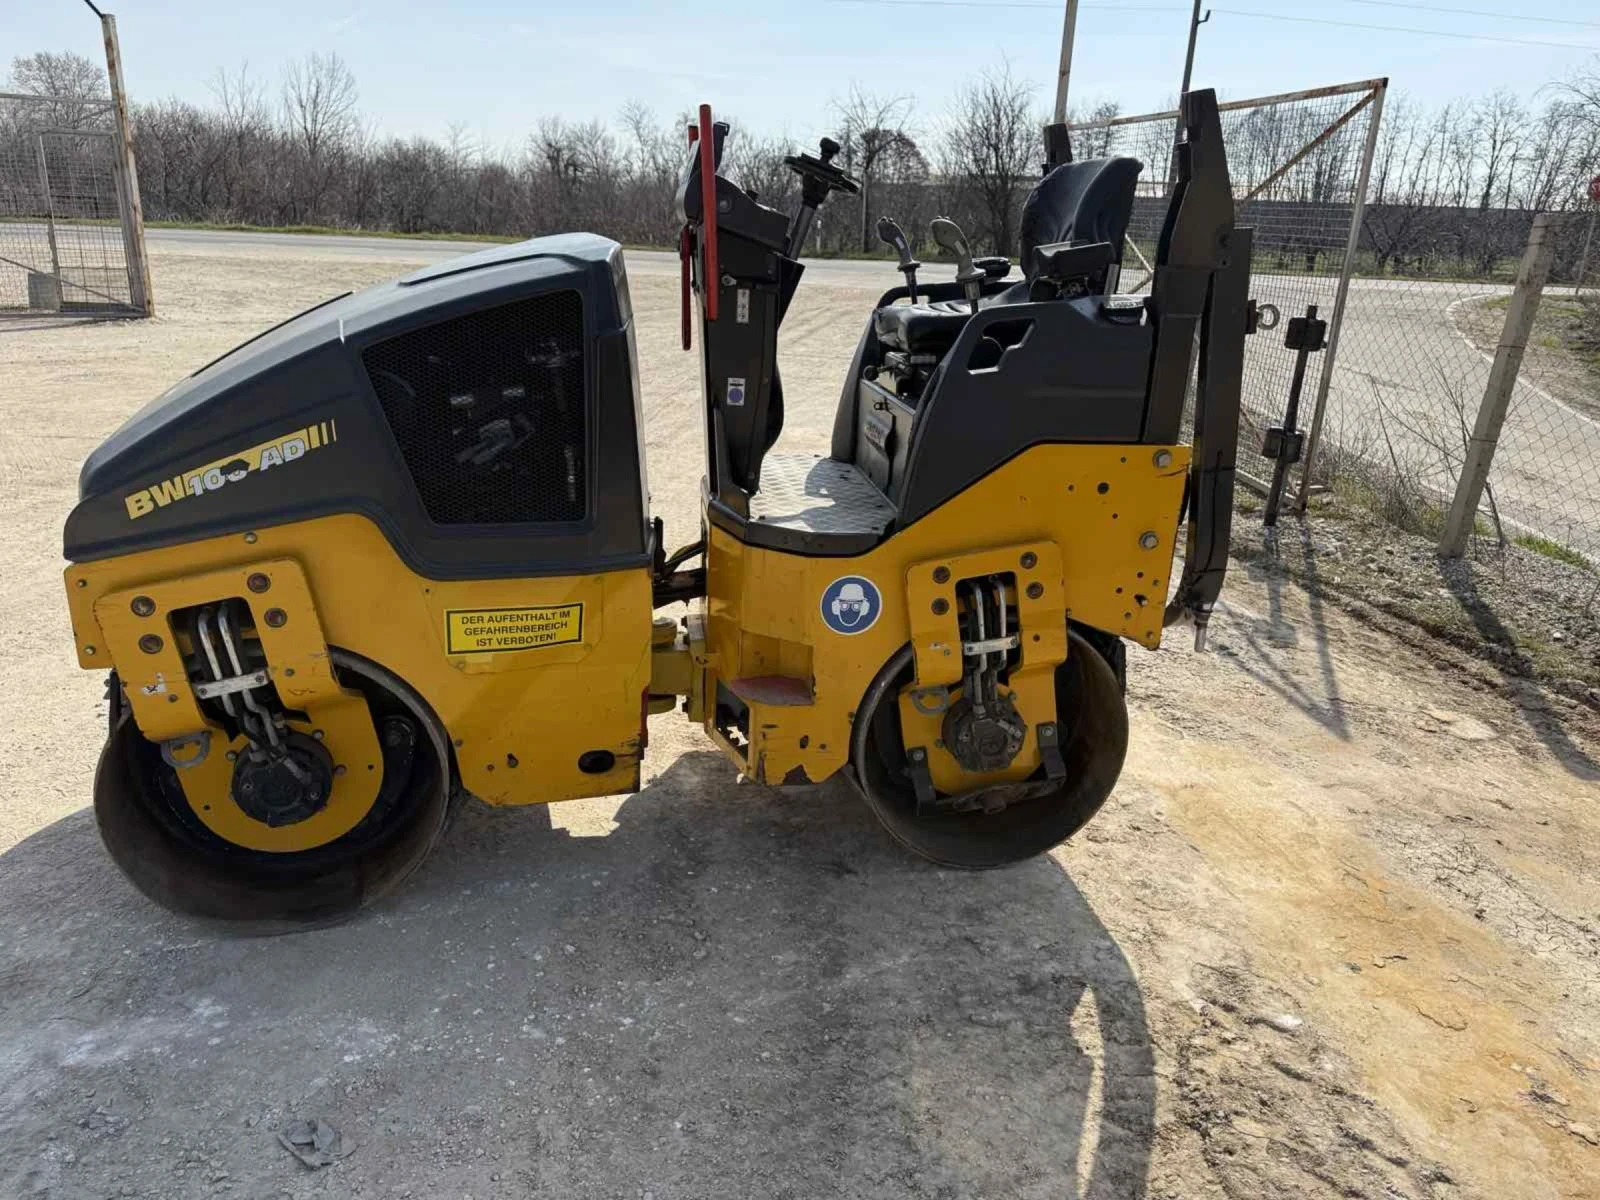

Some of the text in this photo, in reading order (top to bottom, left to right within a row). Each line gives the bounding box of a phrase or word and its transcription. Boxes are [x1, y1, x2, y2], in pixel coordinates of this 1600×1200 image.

[259, 437, 306, 472] AD
[461, 610, 571, 625] DER AUFENTHALT IM
[464, 621, 568, 636] GEFAHRENBEREICH
[476, 633, 557, 647] IST VERBOTEN!
